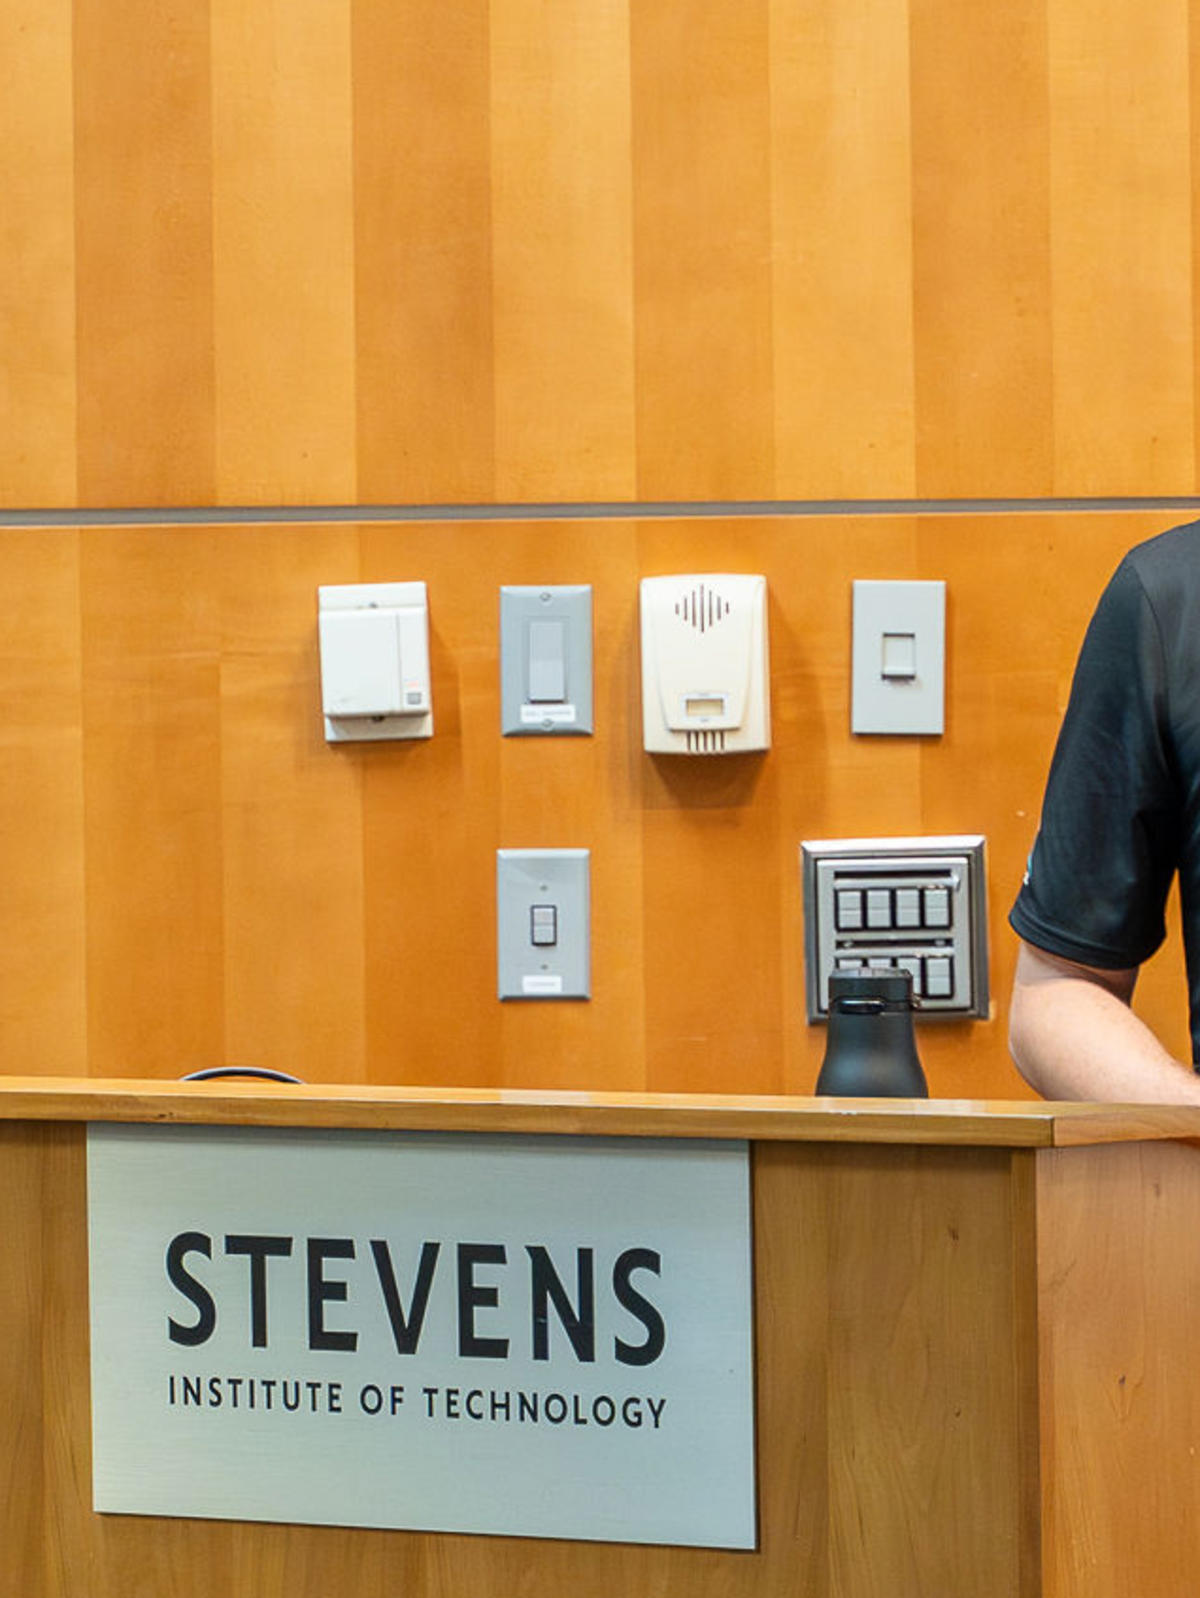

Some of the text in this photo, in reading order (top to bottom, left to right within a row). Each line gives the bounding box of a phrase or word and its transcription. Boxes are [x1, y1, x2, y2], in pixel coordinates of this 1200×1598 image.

[165, 1231, 667, 1366] STEVENS
[168, 1375, 667, 1429] INSTITUTE OF TECHNOLOGY
